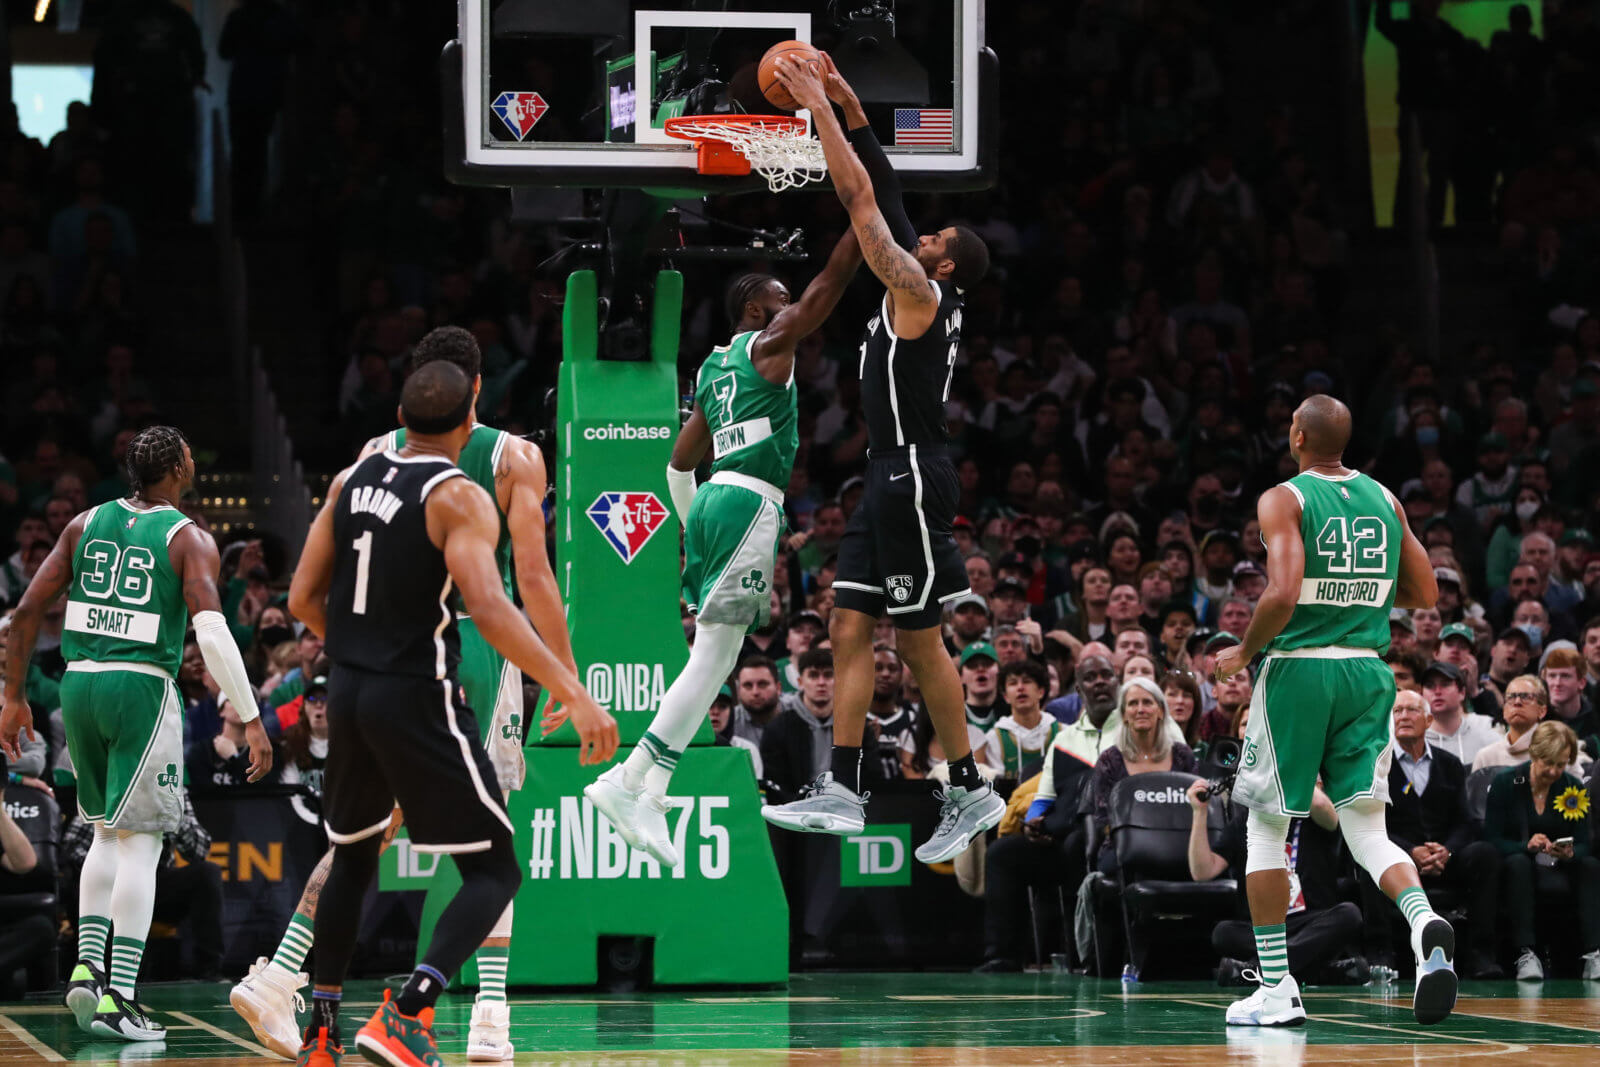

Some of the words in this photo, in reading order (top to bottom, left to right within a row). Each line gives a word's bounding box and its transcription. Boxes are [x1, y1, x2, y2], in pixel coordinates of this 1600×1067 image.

[525, 99, 536, 114] 75
[712, 371, 737, 427] 7
[583, 423, 671, 440] coinbase
[351, 486, 403, 524] BROWN
[635, 502, 651, 524] 75
[1316, 516, 1387, 573] 42
[81, 539, 155, 605] 36
[352, 530, 373, 615] 1
[886, 576, 912, 588] NETS
[1316, 581, 1379, 603] HORFORD
[86, 607, 135, 635] SMART
[586, 663, 666, 711] @NBA
[847, 836, 905, 874] TD
